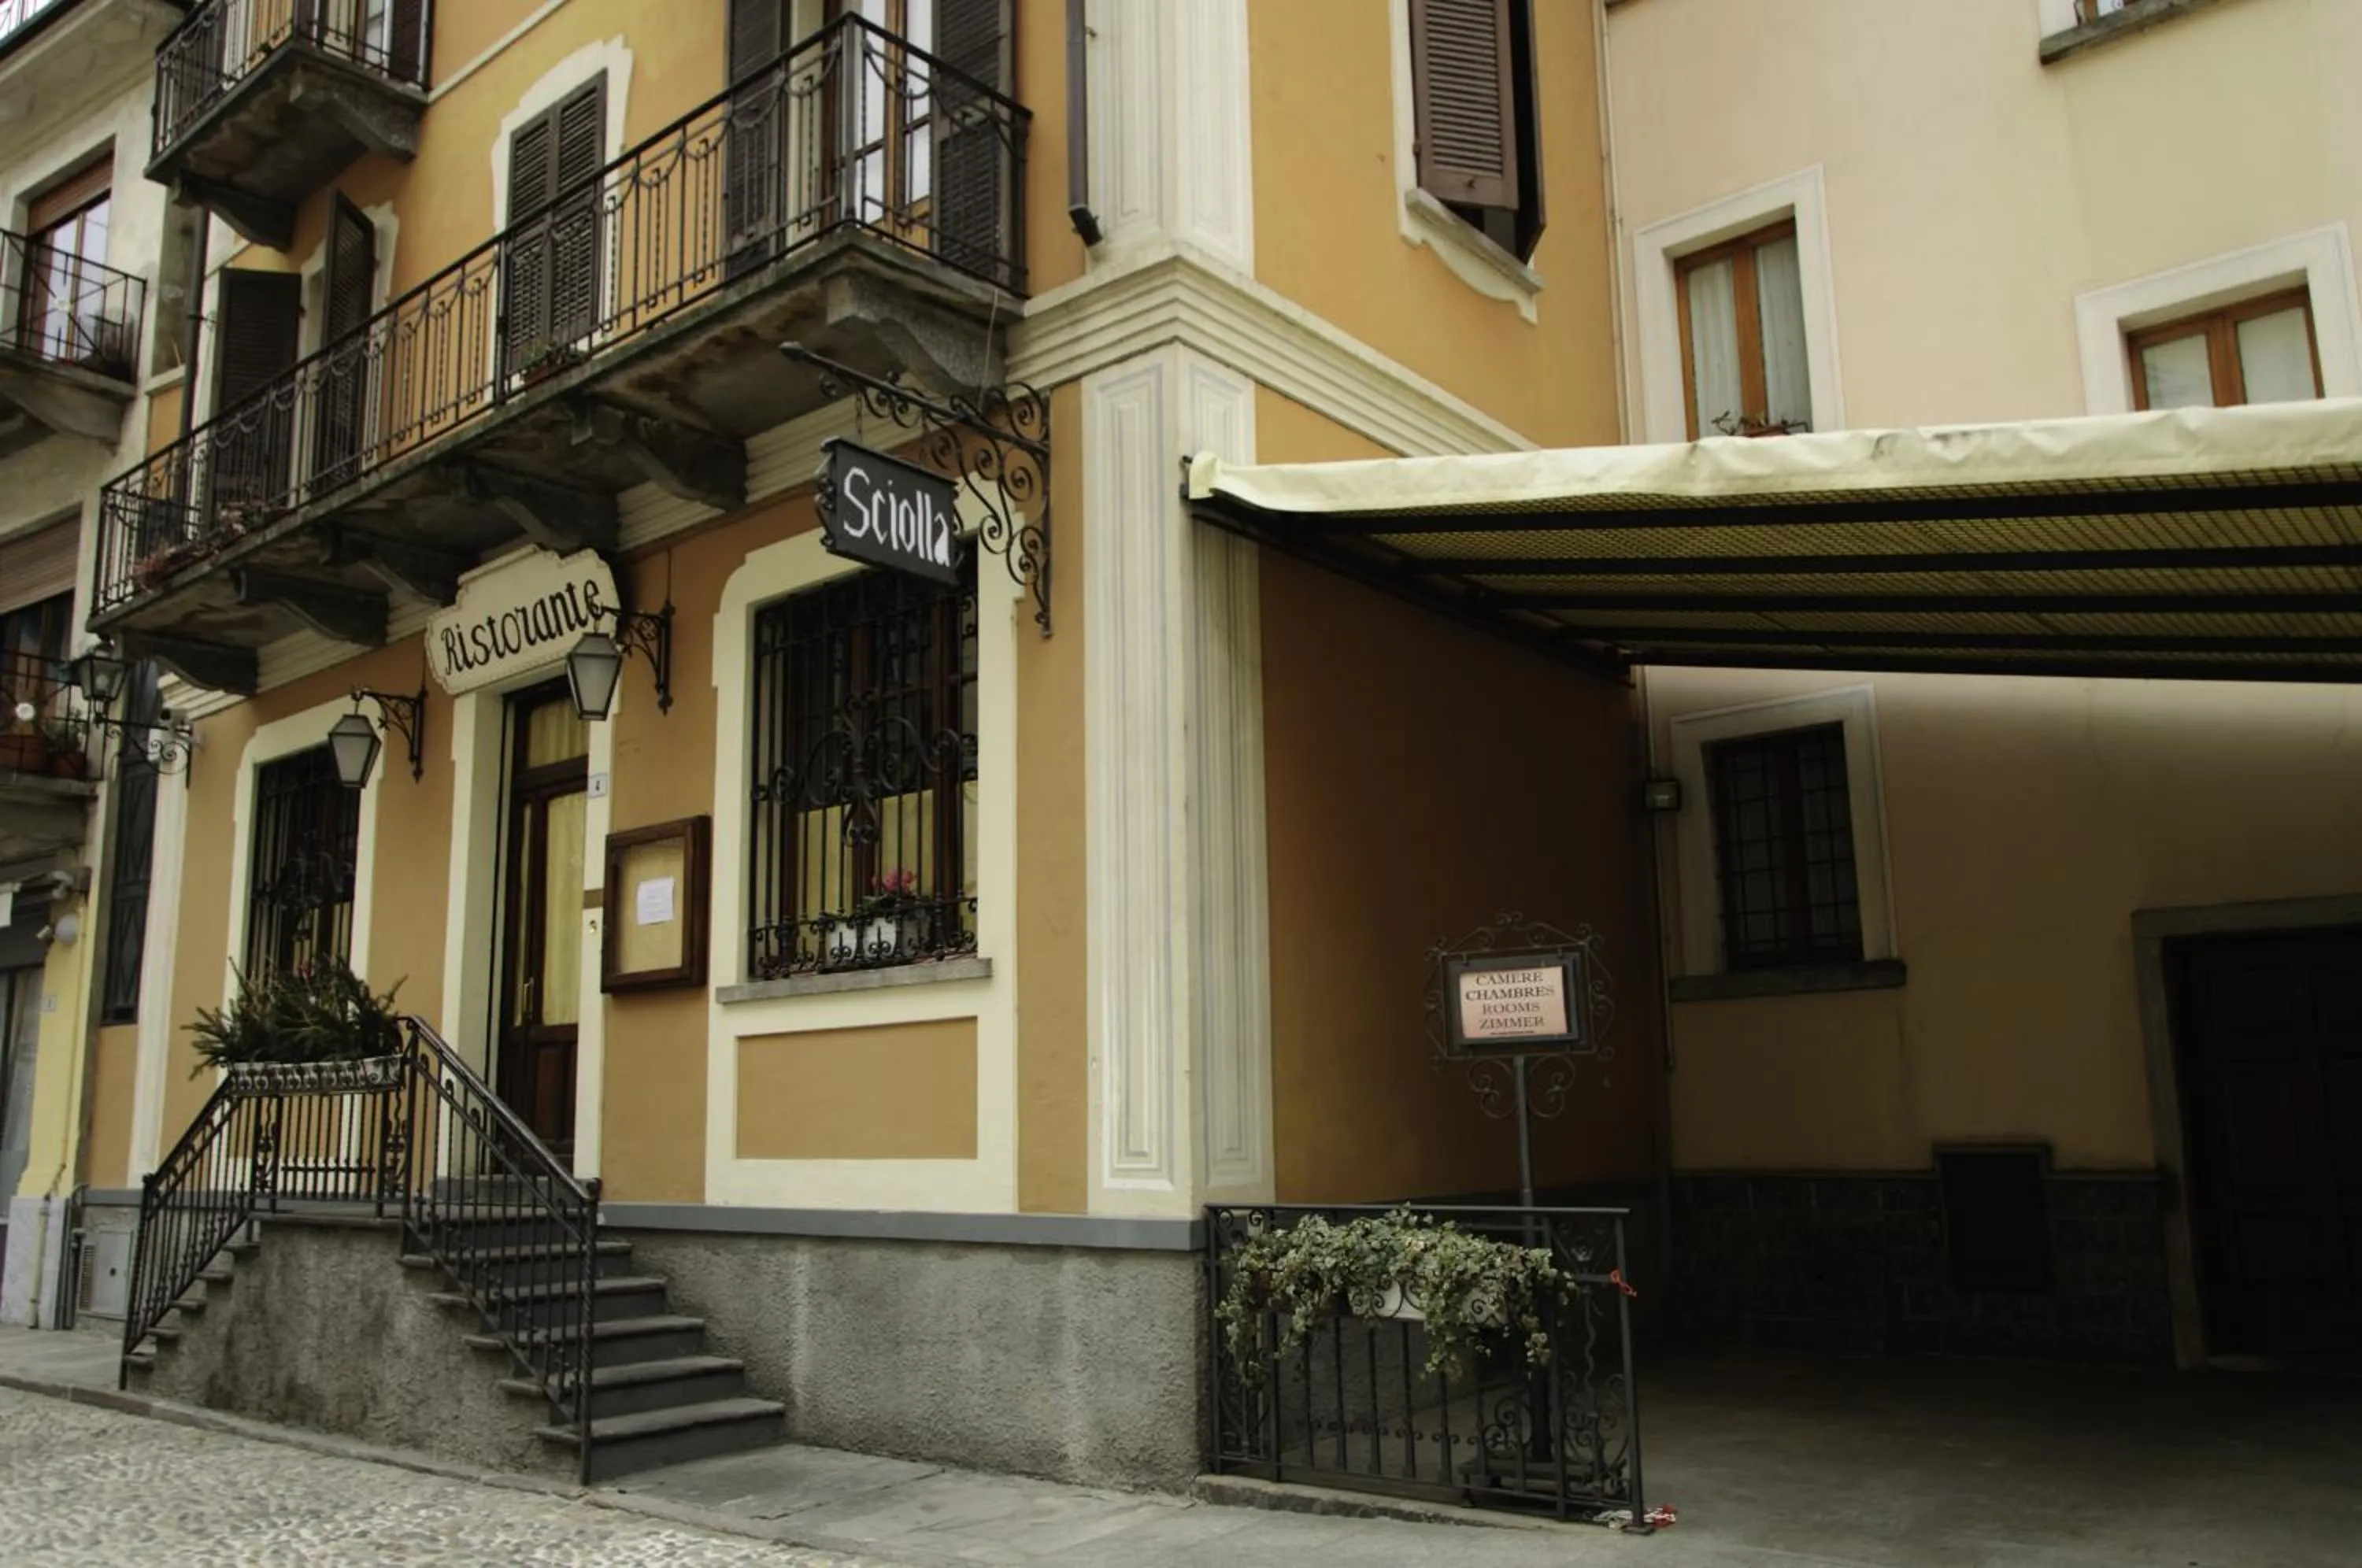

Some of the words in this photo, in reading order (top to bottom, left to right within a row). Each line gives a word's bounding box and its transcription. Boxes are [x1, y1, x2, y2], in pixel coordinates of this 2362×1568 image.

[843, 466, 950, 568] Sciolla
[440, 579, 603, 676] Ristorante
[1475, 971, 1543, 986] CAMERE
[1465, 985, 1556, 1001] CHAMBRES
[1483, 1001, 1541, 1015] ROOMS
[1479, 1015, 1546, 1030] ZIMMER
